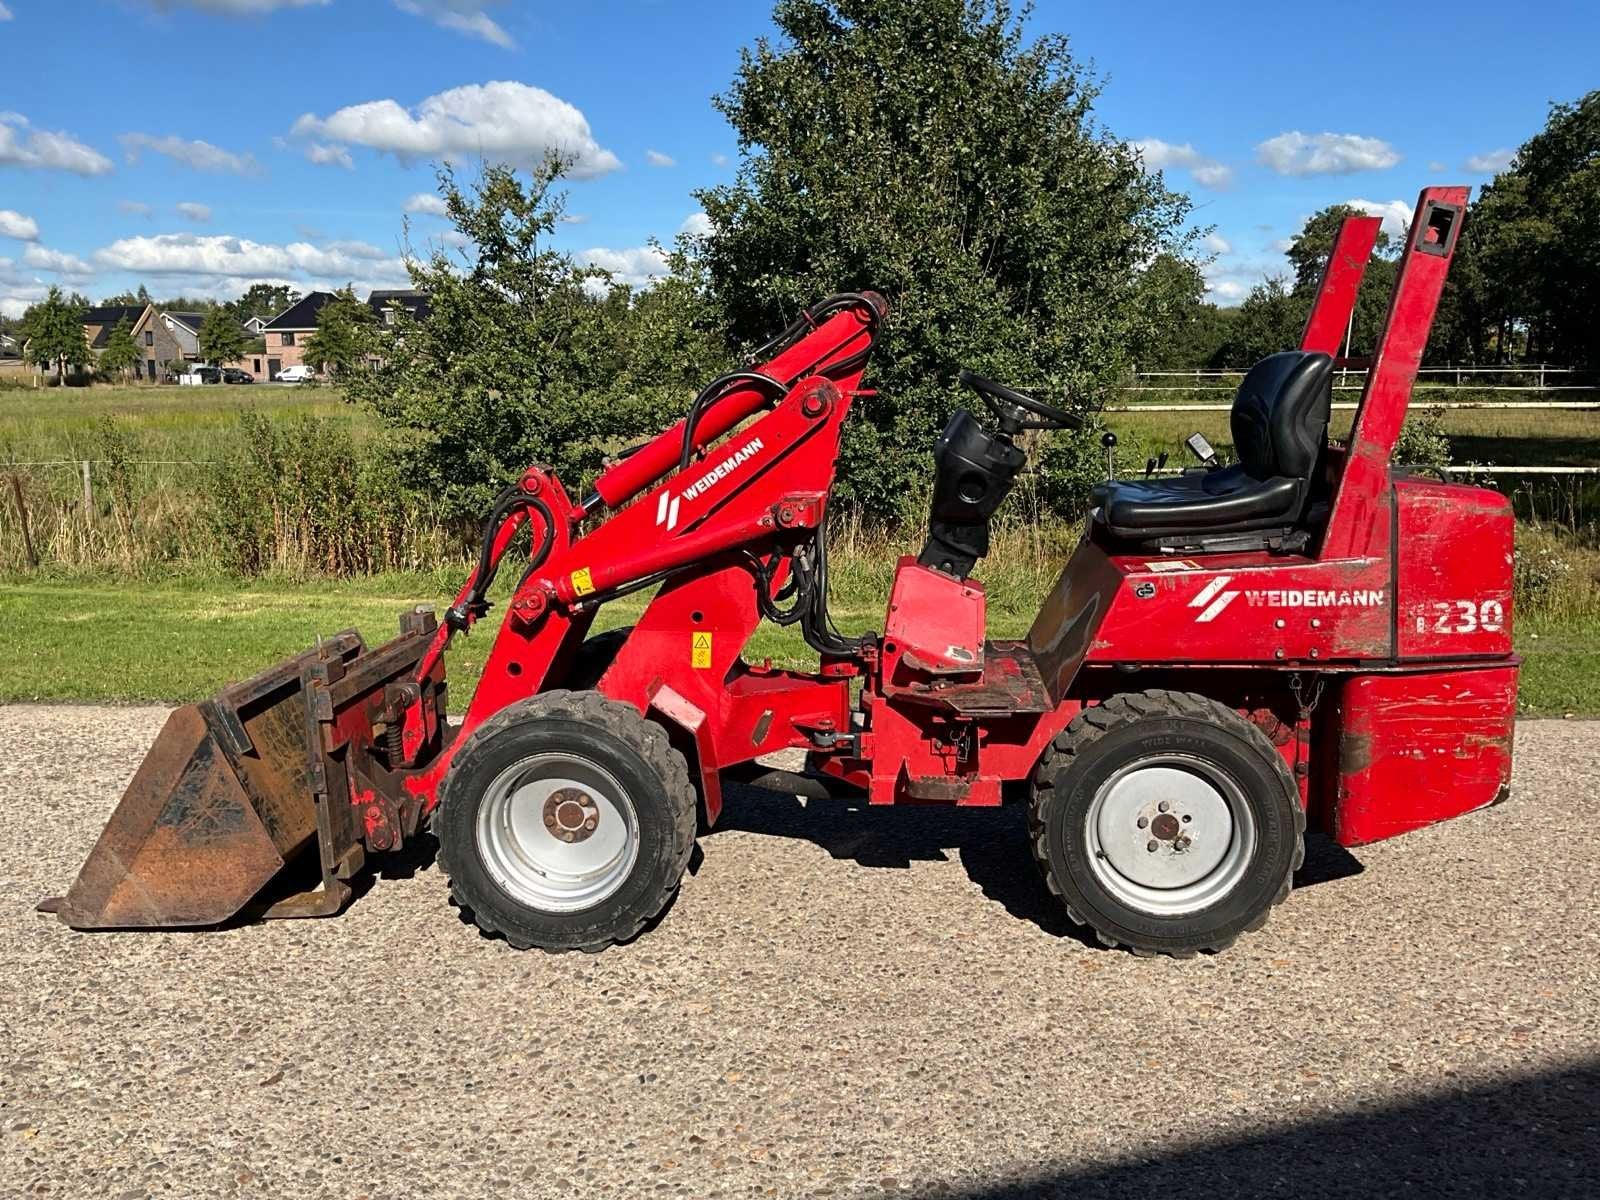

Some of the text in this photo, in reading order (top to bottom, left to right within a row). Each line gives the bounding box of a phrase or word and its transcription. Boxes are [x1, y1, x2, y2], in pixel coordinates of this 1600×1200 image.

[682, 437, 764, 501] WEIDEMANN
[1244, 589, 1384, 607] WEIDEMANN
[1408, 600, 1503, 633] 1230
